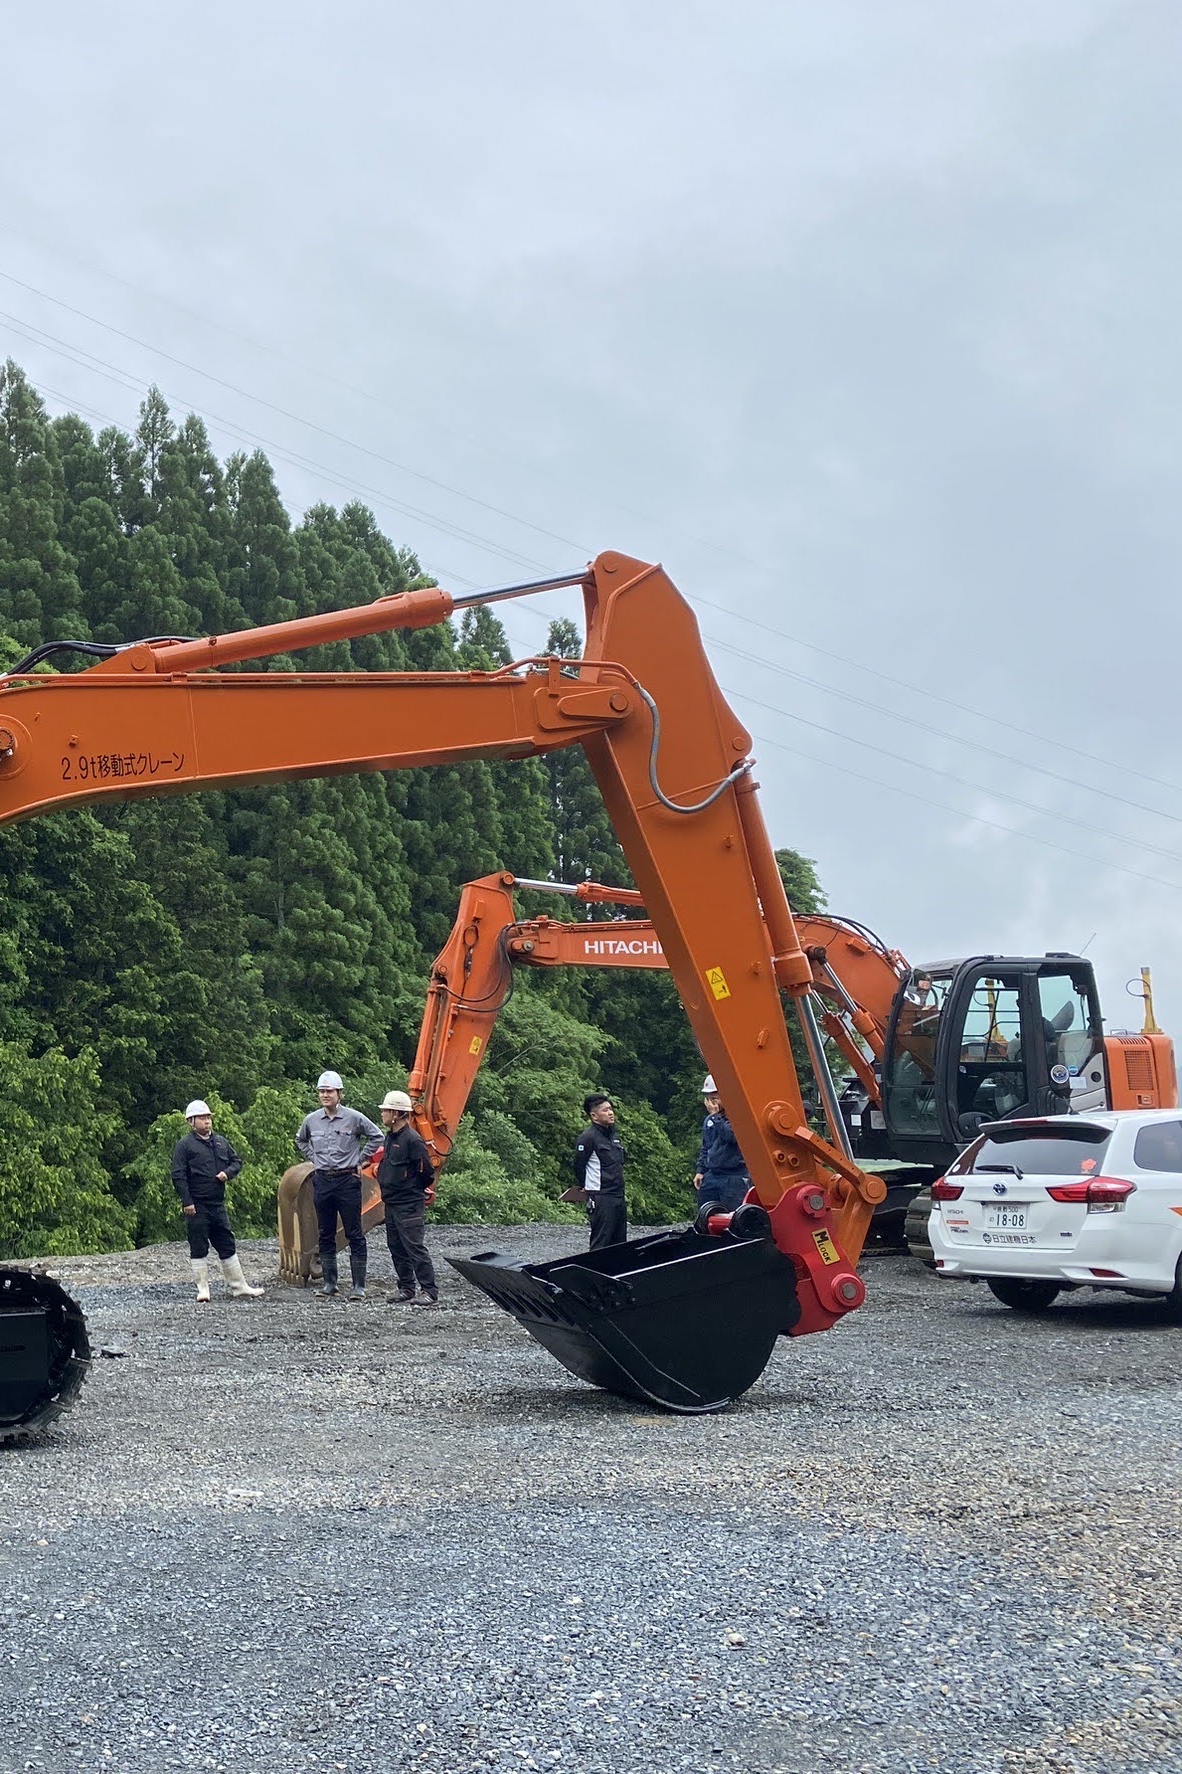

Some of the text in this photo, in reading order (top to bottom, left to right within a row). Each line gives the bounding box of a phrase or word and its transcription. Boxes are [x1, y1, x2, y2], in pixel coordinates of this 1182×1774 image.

[61, 752, 185, 780] 2.9t移動式クレーン
[996, 1214, 1025, 1227] 18-08
